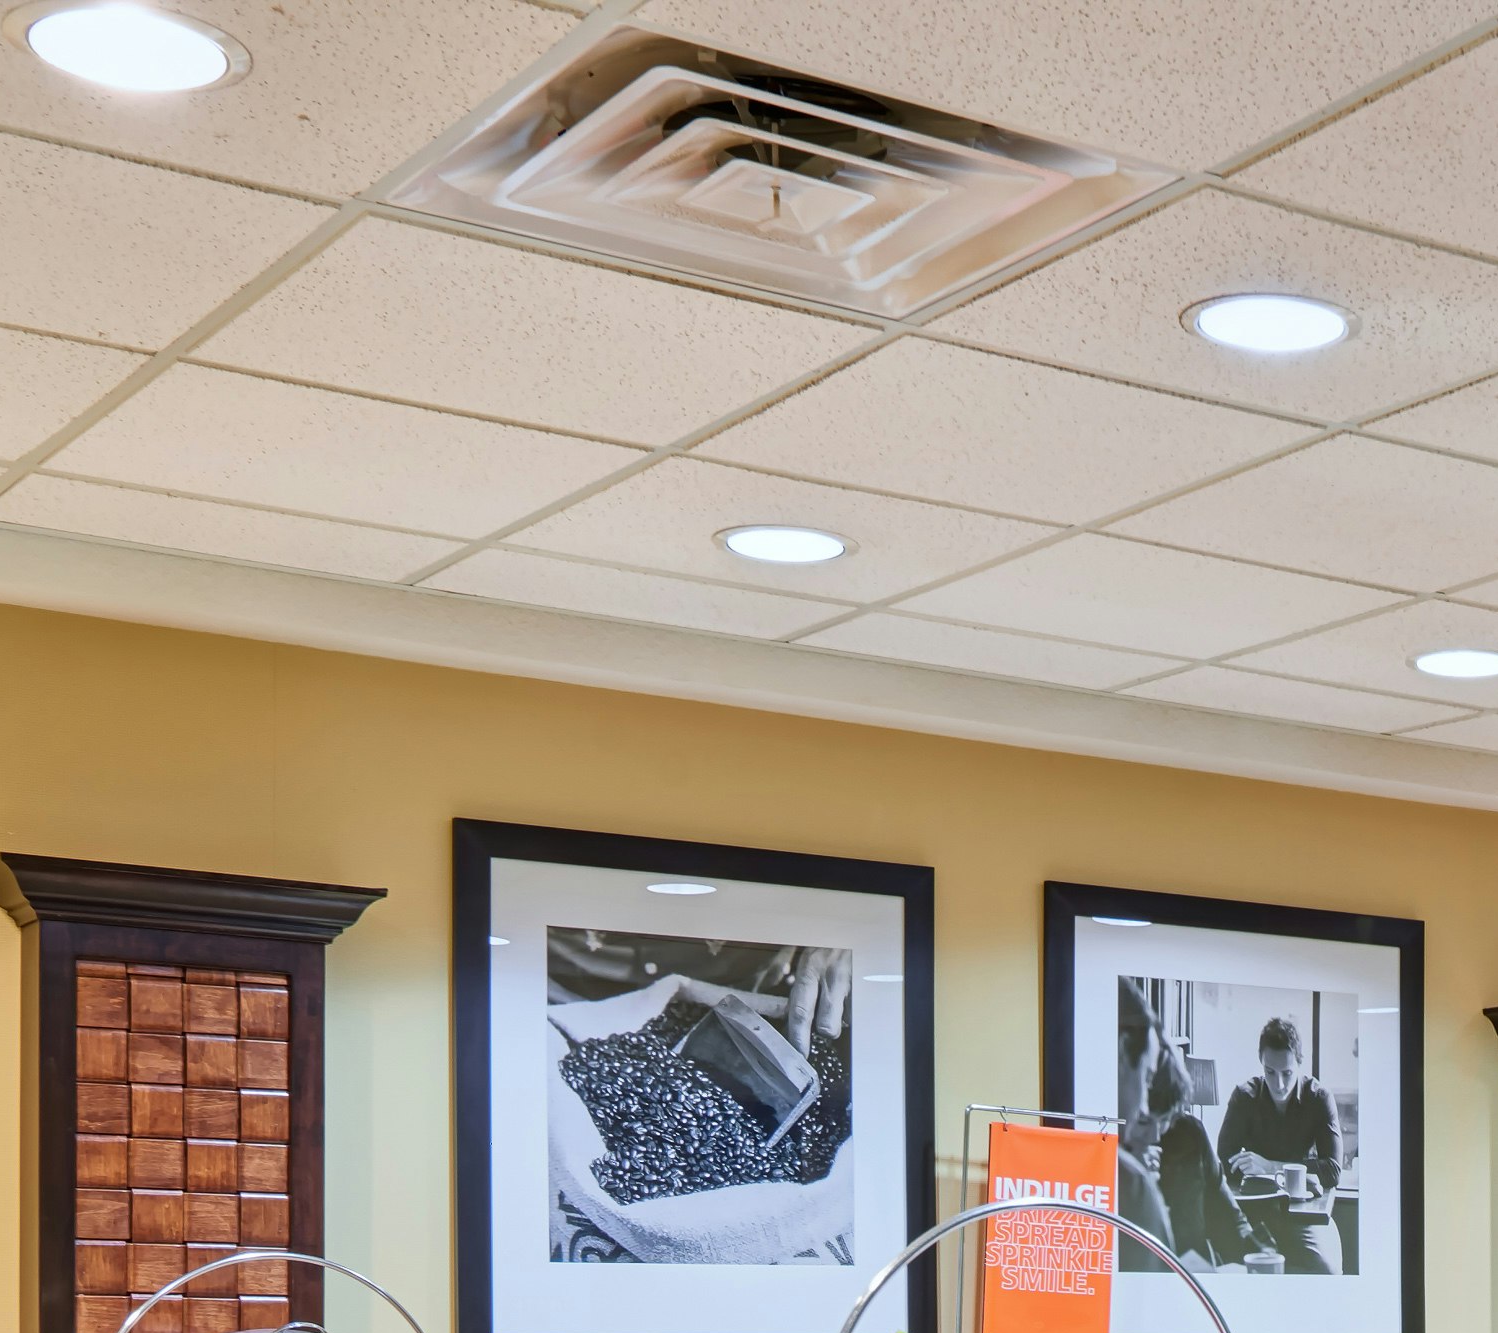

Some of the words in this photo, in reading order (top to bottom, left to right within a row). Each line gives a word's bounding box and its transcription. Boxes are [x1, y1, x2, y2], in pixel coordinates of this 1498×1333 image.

[995, 1176, 1110, 1210] INDULGE
[994, 1220, 1107, 1252] SPREAD
[984, 1241, 1113, 1275] SPRINKLE
[1001, 1264, 1096, 1296] SMILE.
